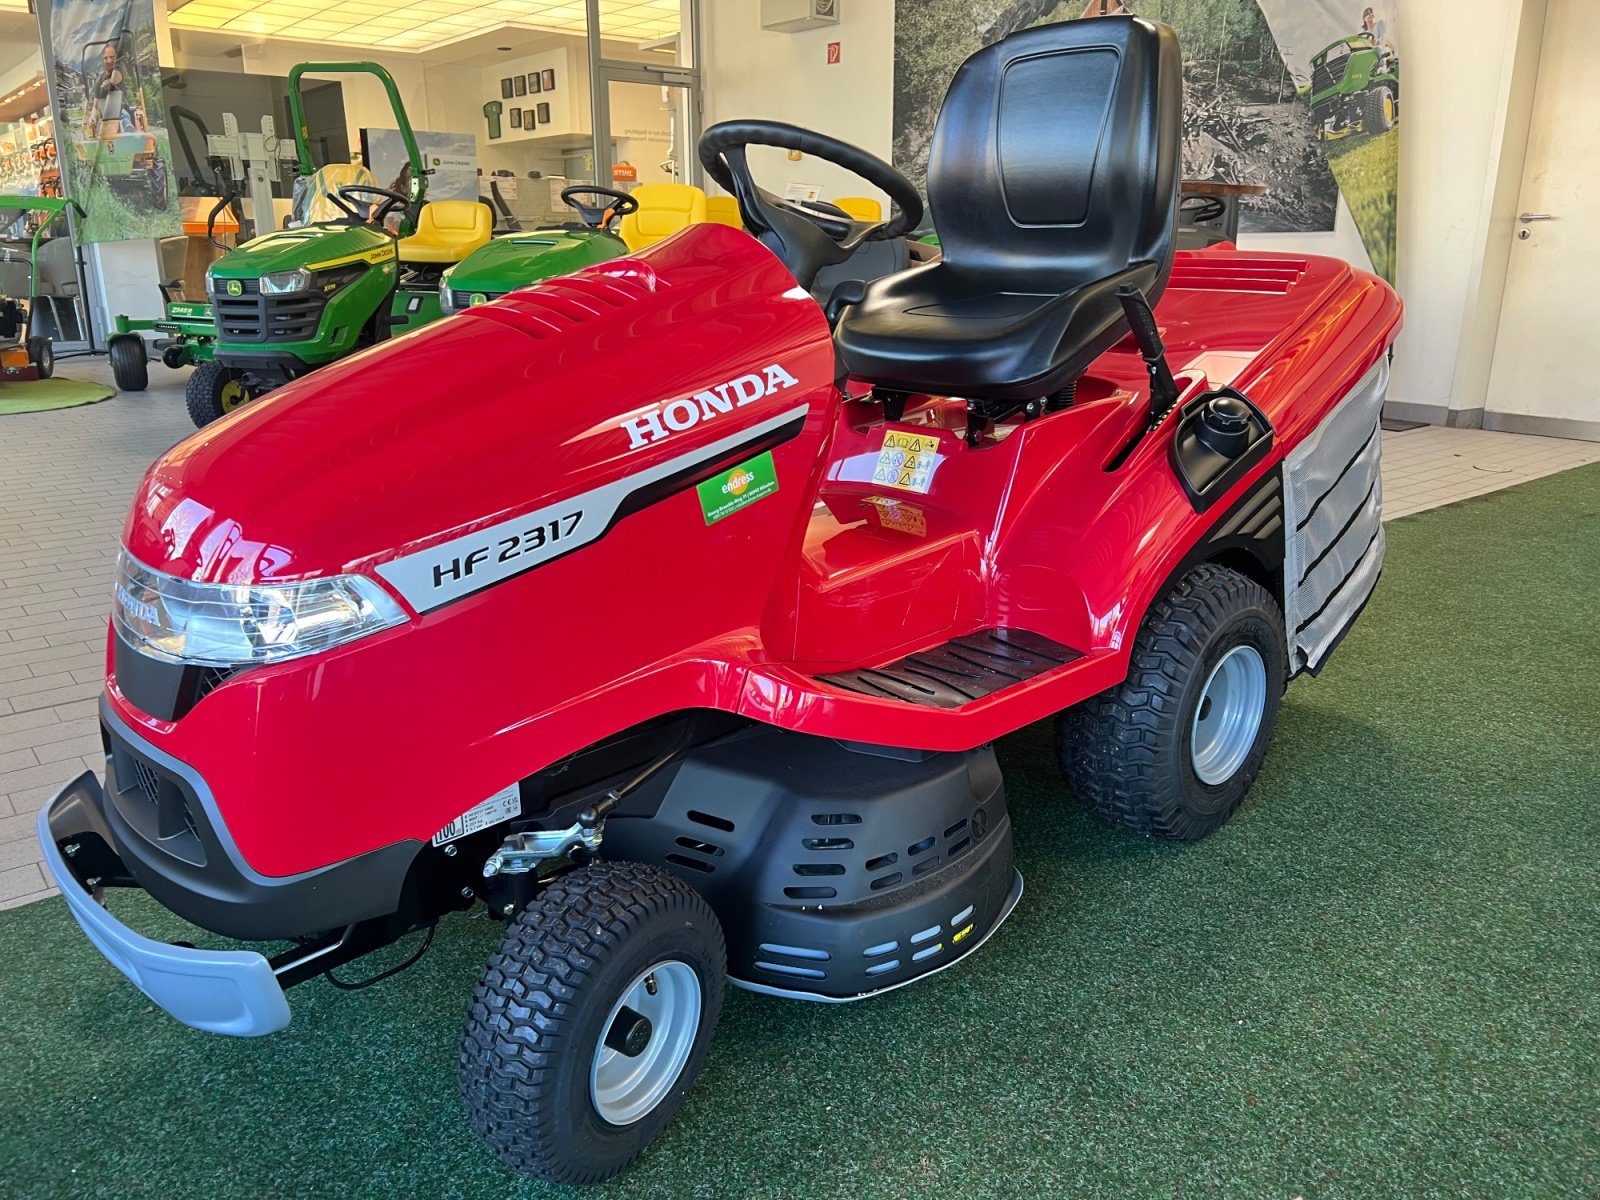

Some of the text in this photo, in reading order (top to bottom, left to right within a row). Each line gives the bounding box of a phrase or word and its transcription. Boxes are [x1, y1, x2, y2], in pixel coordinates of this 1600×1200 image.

[613, 169, 634, 177] STIHL
[370, 247, 394, 260] JOHN DEERE
[619, 363, 799, 451] HONDA
[721, 471, 755, 494] endress
[433, 510, 584, 588] HF 2317
